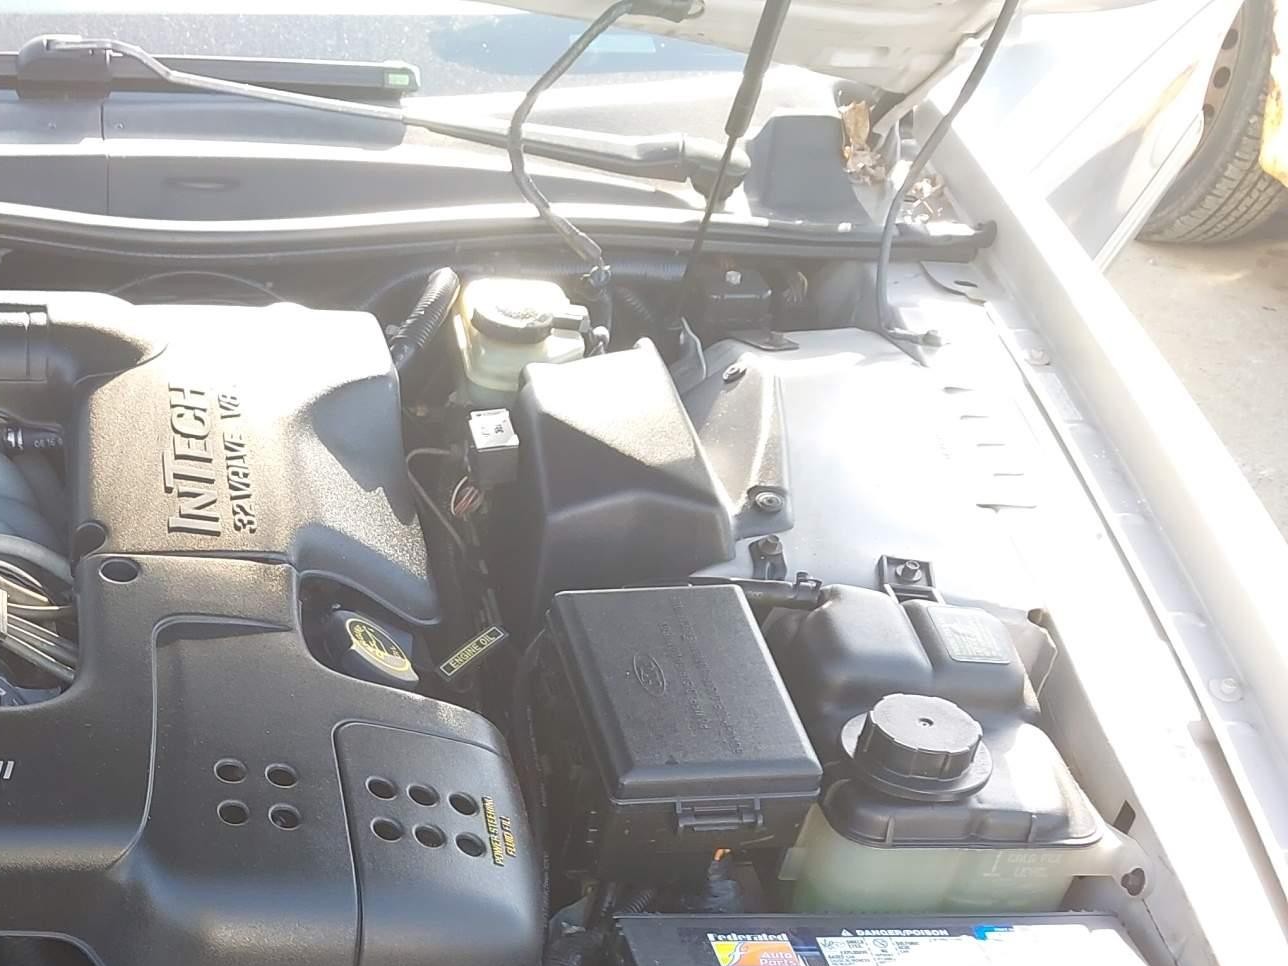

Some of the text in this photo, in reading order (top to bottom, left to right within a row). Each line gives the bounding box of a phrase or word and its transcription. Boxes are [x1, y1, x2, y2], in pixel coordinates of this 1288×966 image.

[450, 633, 496, 669] ENGINE OIL
[481, 795, 505, 867] POWER STEERING
[503, 831, 516, 857] FLUID
[707, 932, 790, 941] Federated
[759, 959, 797, 966] Parts
